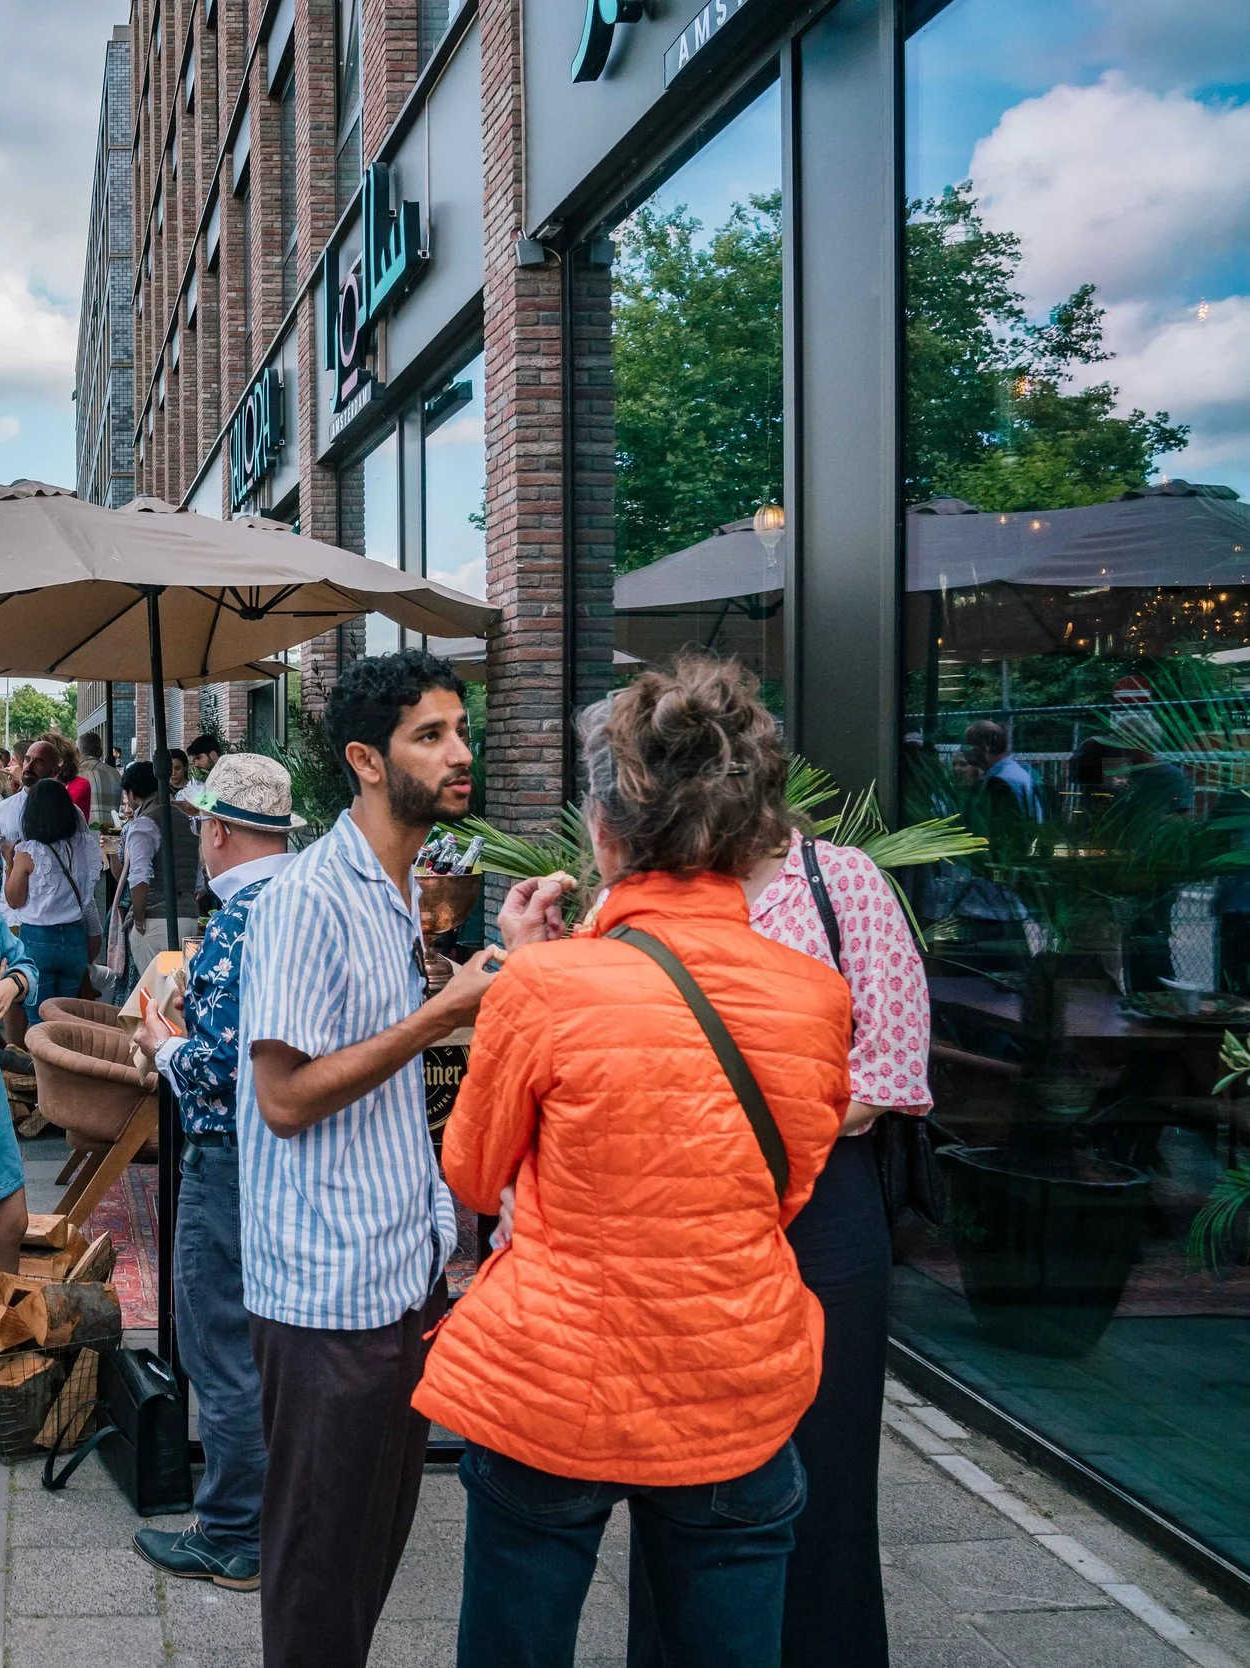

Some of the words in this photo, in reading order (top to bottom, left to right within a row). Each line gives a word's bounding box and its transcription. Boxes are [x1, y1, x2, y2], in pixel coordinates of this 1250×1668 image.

[678, 0, 743, 69] AMS
[330, 385, 369, 439] AMSTERDAM
[424, 1061, 462, 1086] iner
